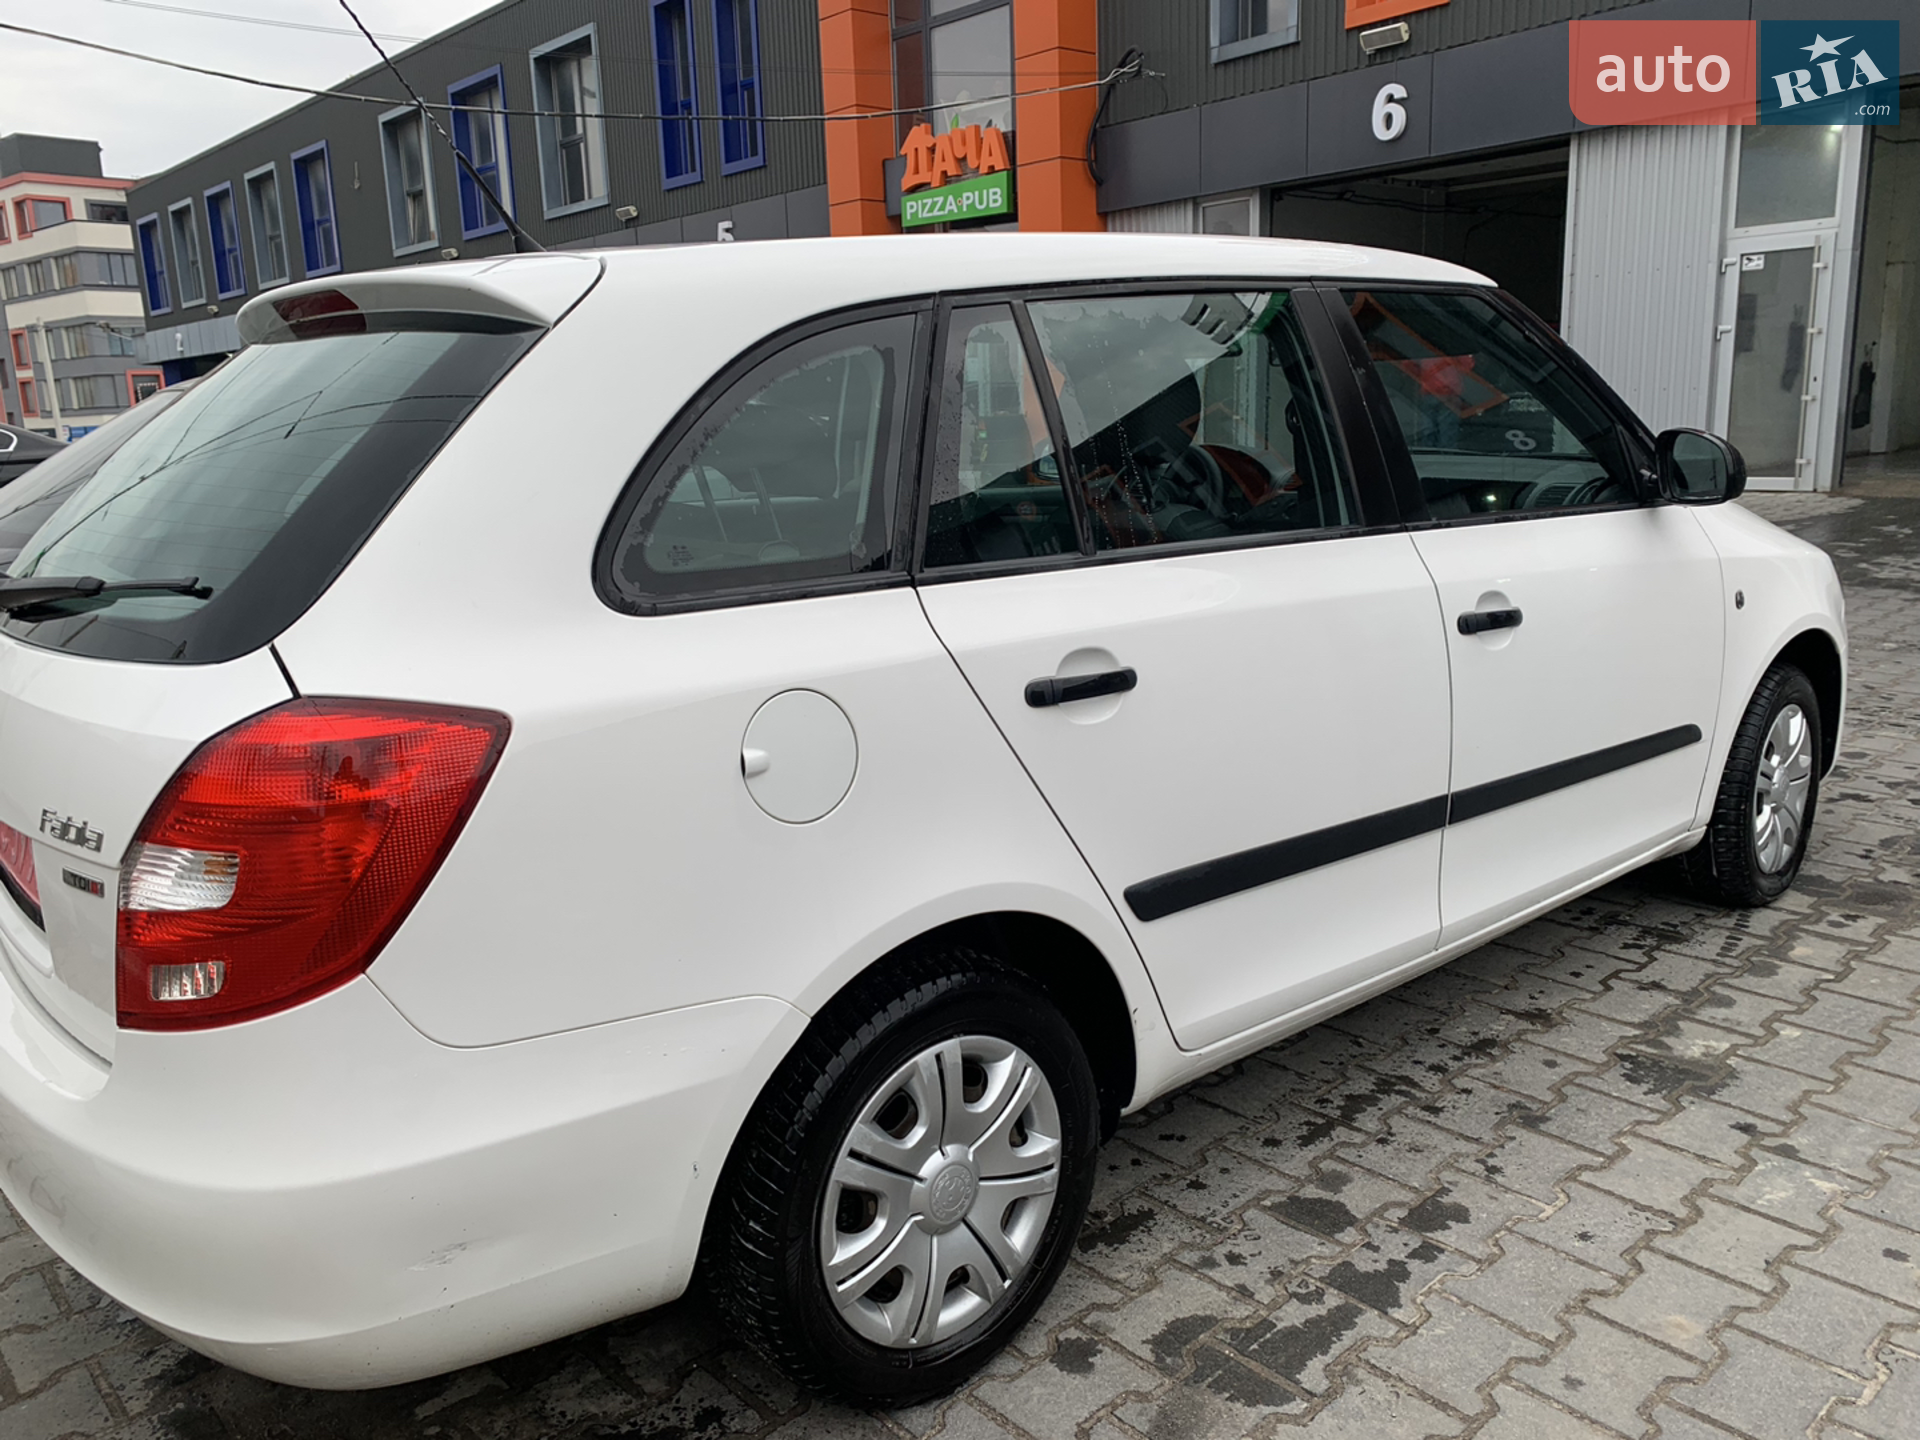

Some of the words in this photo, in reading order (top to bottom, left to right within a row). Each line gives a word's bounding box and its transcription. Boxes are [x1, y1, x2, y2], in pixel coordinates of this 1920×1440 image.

[1371, 82, 1408, 141] 6
[900, 123, 1011, 192] ДАЧА
[906, 194, 958, 220] PIZZA
[962, 187, 1003, 212] PUB
[39, 806, 104, 853] Fabia
